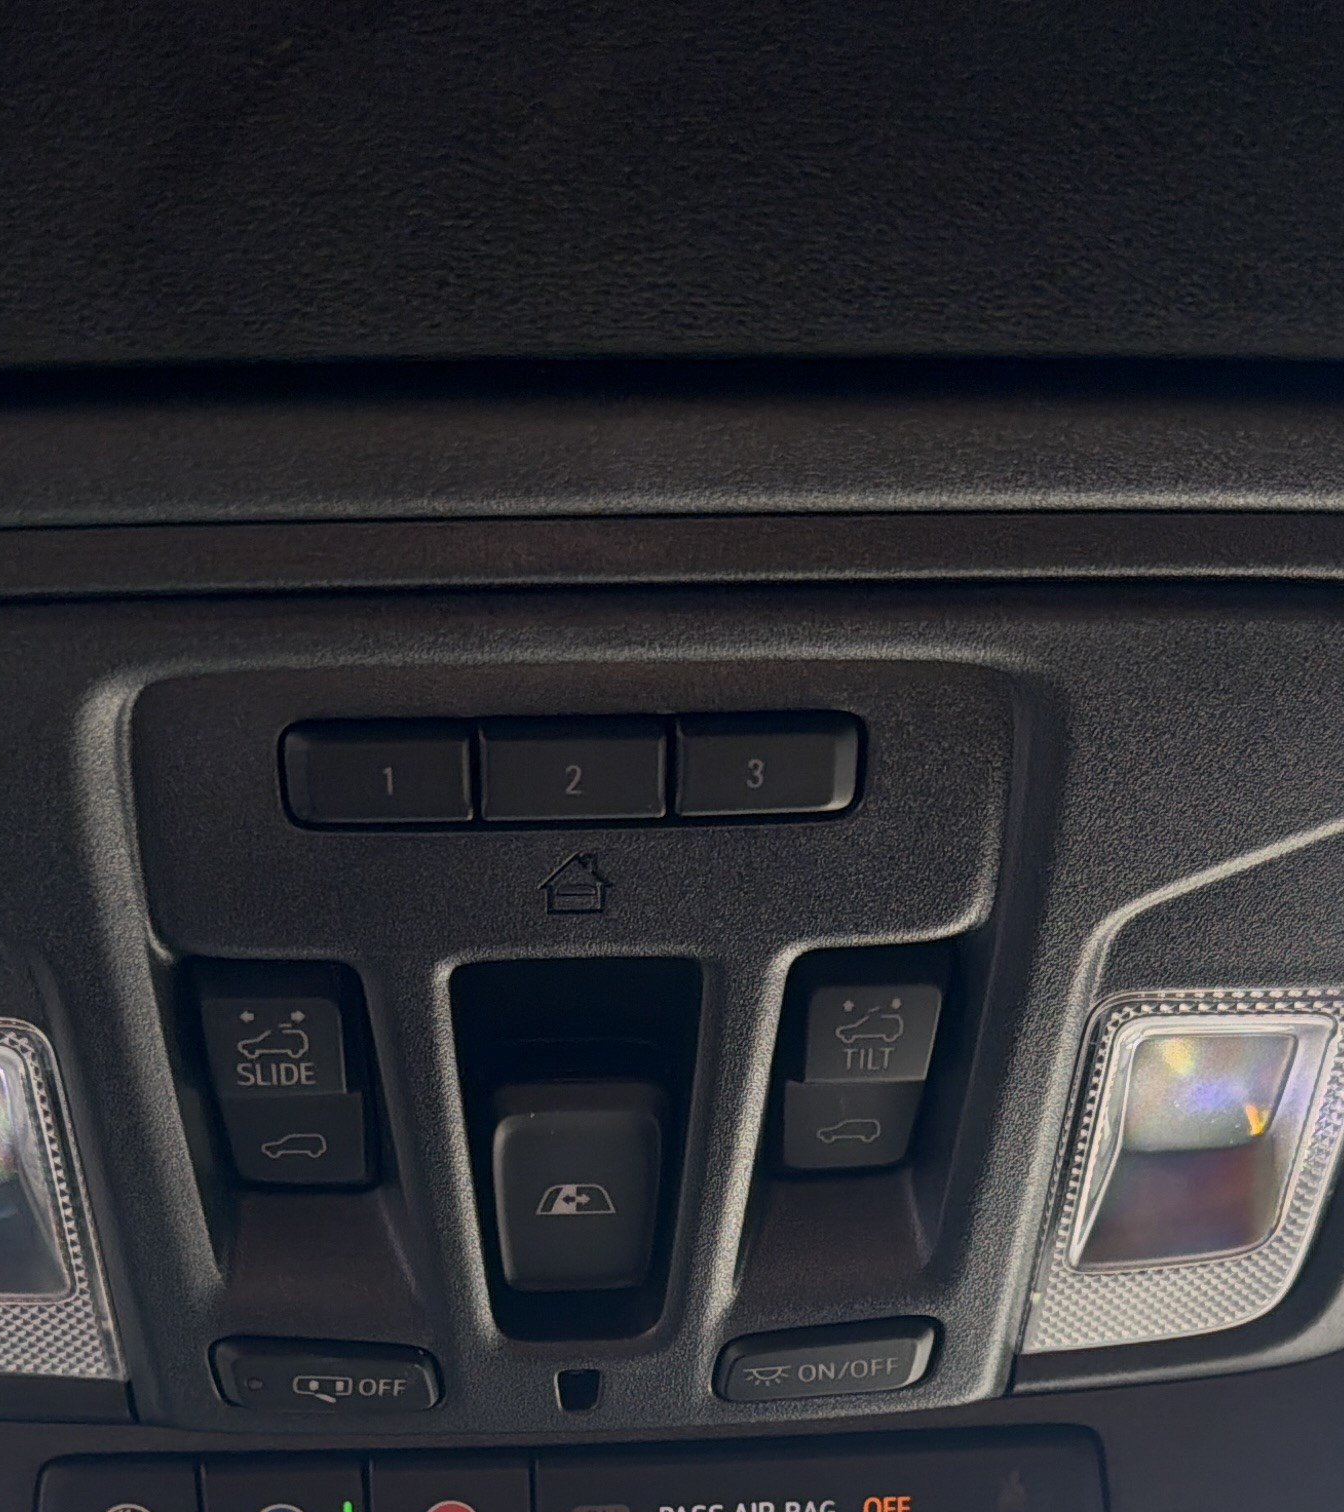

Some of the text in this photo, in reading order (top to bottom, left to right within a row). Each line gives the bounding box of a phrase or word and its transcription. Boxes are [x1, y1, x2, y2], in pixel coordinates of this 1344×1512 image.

[383, 768, 395, 793] 1
[564, 764, 582, 794] 2
[746, 759, 765, 789] 3
[842, 1046, 894, 1071] TILT
[235, 1061, 316, 1087] SLIDE
[796, 1356, 899, 1383] ON/OFF
[358, 1376, 408, 1398] OFF
